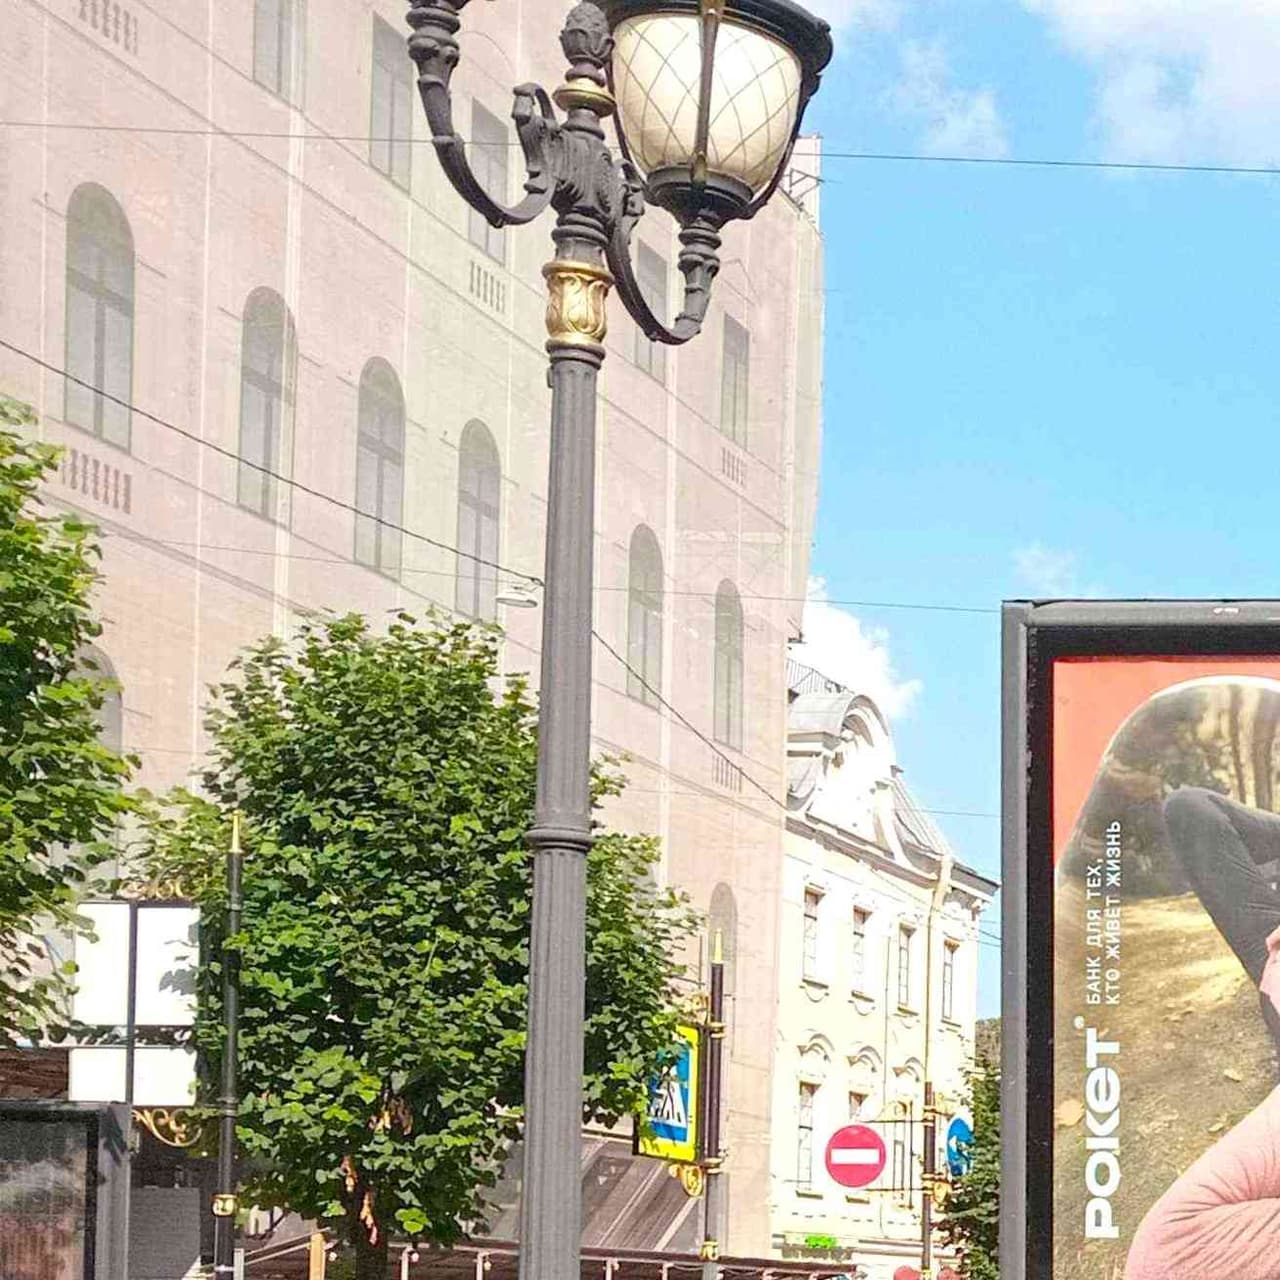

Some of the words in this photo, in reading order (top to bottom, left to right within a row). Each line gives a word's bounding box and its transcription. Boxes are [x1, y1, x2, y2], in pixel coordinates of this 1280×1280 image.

[1105, 821, 1121, 886] ЖИЗНЬ
[1087, 858, 1104, 899] ТЕХ,
[1087, 909, 1103, 948] ДЛЯ
[1087, 957, 1101, 1005] БАНК
[1105, 968, 1120, 1005] КТО
